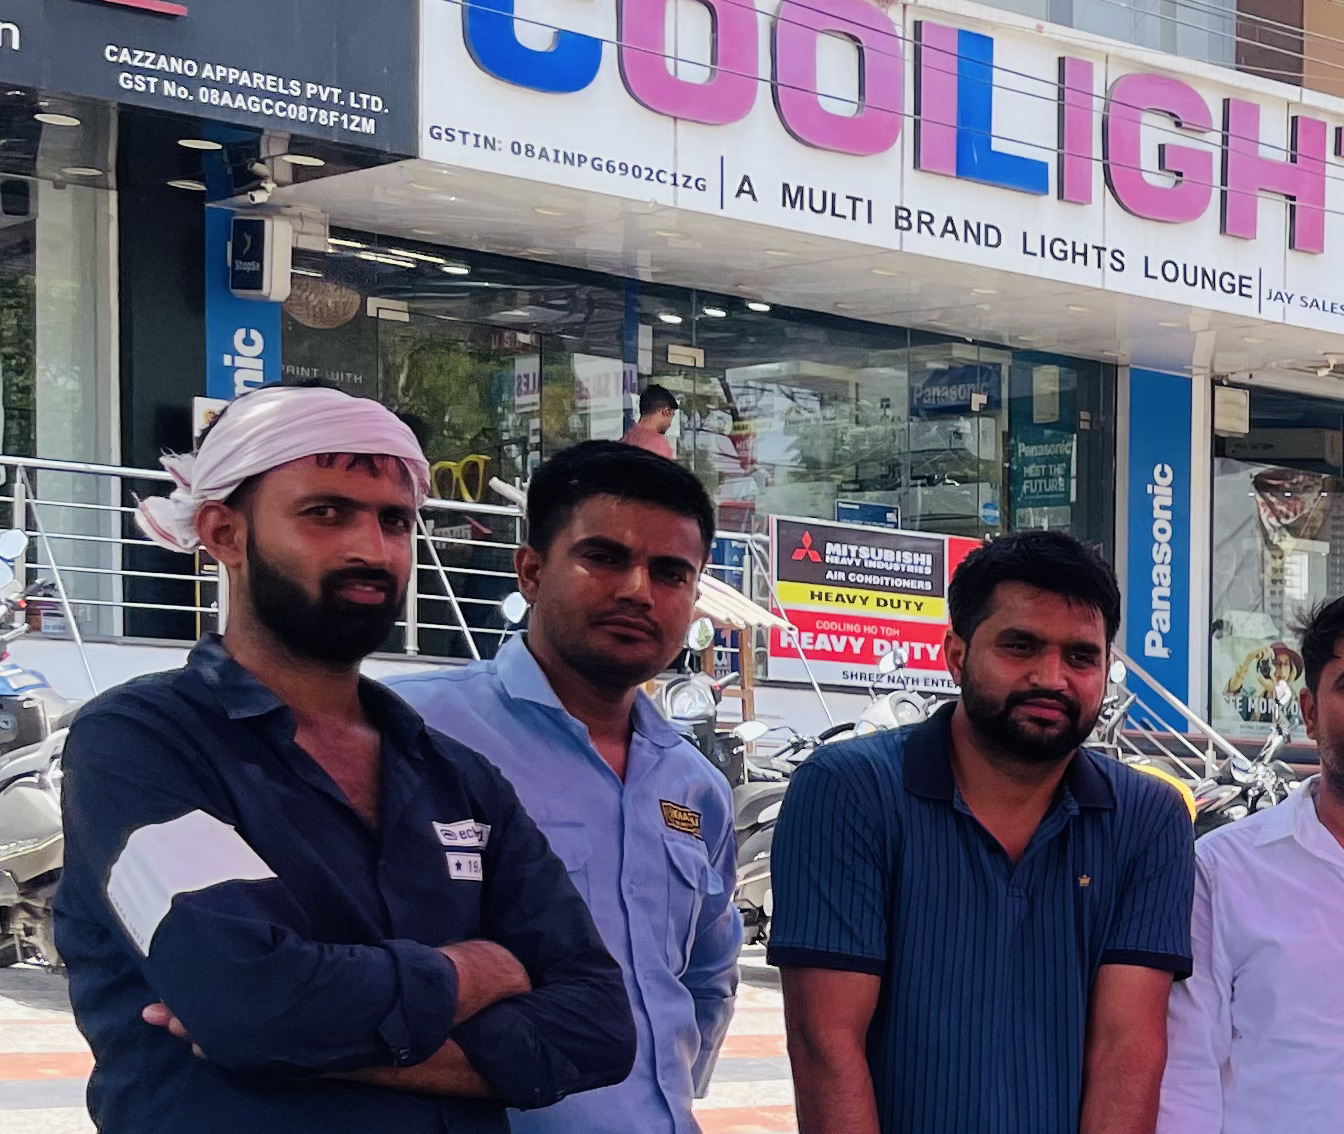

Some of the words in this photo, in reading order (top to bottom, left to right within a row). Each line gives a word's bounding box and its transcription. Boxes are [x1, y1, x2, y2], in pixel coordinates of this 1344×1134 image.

[104, 45, 198, 77] CAZZANO
[201, 62, 301, 97] APPARELS
[305, 82, 345, 106] PVT.
[350, 91, 389, 114] LTD.
[119, 72, 156, 94] GST
[163, 81, 194, 102] No.
[429, 124, 503, 153] GSTIN:
[735, 174, 758, 202] A
[781, 182, 873, 225] MULTI
[895, 206, 1002, 249] BRAND
[1022, 231, 1126, 273] LIGHTS
[1144, 256, 1253, 298] LOUNGE
[1266, 288, 1293, 306] JAY
[325, 370, 363, 384] WITH
[1018, 441, 1072, 459] Panasonic
[825, 542, 934, 566] MITSUBISHI
[825, 556, 862, 568] HEAVY
[864, 558, 933, 575] INDUSTRIES
[1145, 463, 1174, 659] Panasonic
[825, 570, 846, 582] AIR
[848, 572, 933, 591] CONDITIONERS
[809, 589, 871, 606] HEAVY
[876, 597, 925, 612] DUTY
[815, 620, 861, 633] COOLING
[780, 630, 865, 655] HEAVY
[887, 674, 920, 687] NATH
